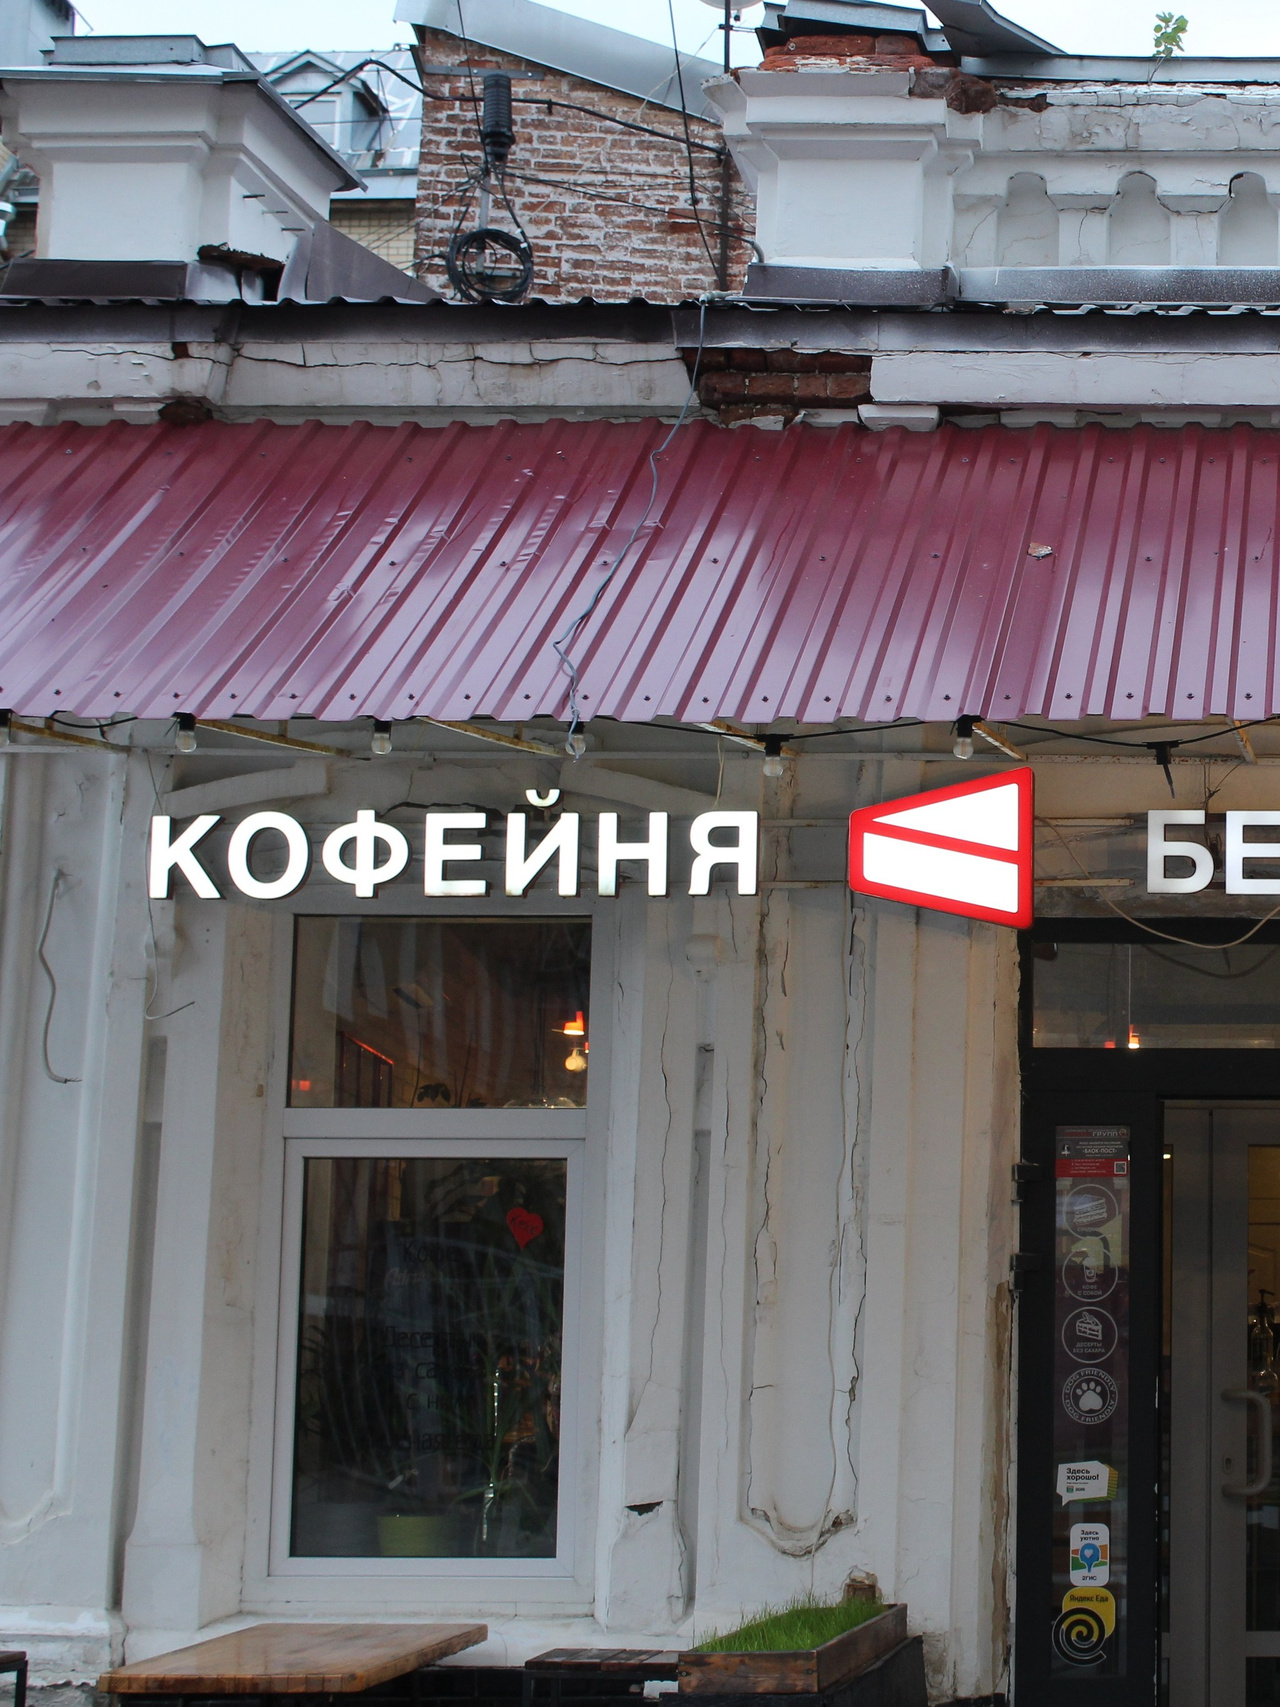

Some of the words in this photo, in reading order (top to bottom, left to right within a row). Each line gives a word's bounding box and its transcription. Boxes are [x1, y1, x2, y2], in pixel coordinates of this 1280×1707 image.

[148, 788, 760, 900] КОФЕЙНЯ
[1065, 1374, 1080, 1394] DOG
[1080, 1369, 1116, 1392] FRIENDLY
[1065, 1399, 1080, 1419] DOG
[1080, 1399, 1116, 1423] FRIENDLY
[1066, 1467, 1090, 1475] Здесь
[1066, 1474, 1099, 1482] хорошо!
[1069, 1594, 1094, 1603] Яндекс
[1095, 1594, 1109, 1603] Еда
